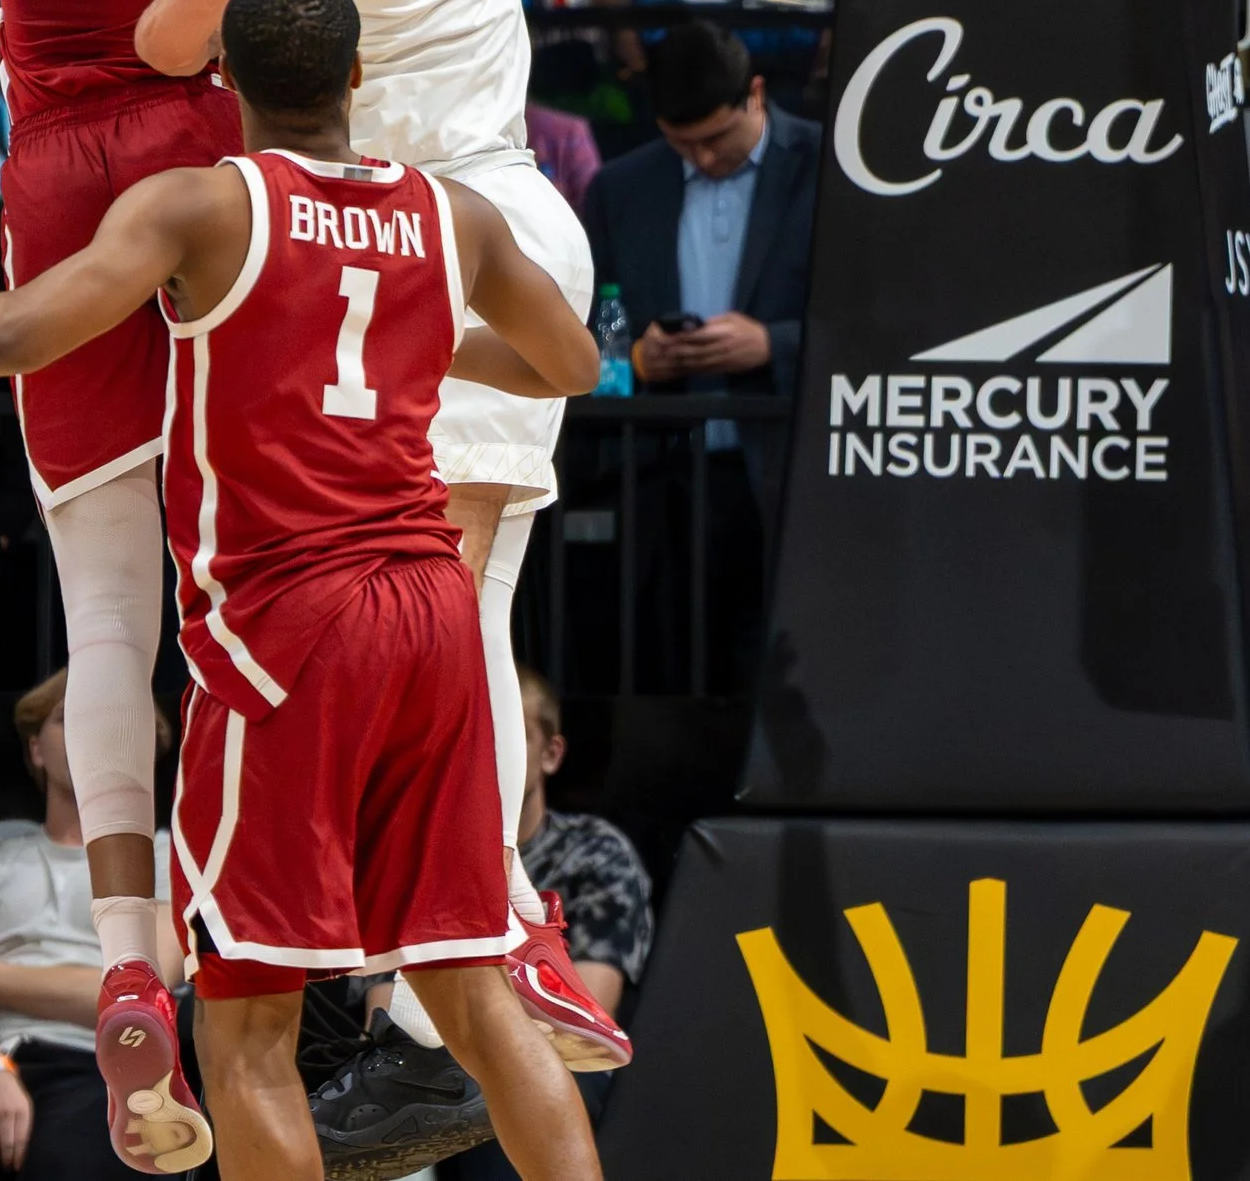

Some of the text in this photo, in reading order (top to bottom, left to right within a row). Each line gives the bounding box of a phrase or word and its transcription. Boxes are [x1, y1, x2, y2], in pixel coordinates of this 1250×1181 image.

[833, 16, 1185, 197] Circa
[288, 194, 426, 259] BROWN
[1225, 228, 1250, 297] JS
[321, 265, 381, 421] 1
[830, 374, 1170, 431] MERCURY
[828, 431, 1169, 481] INSURANCE
